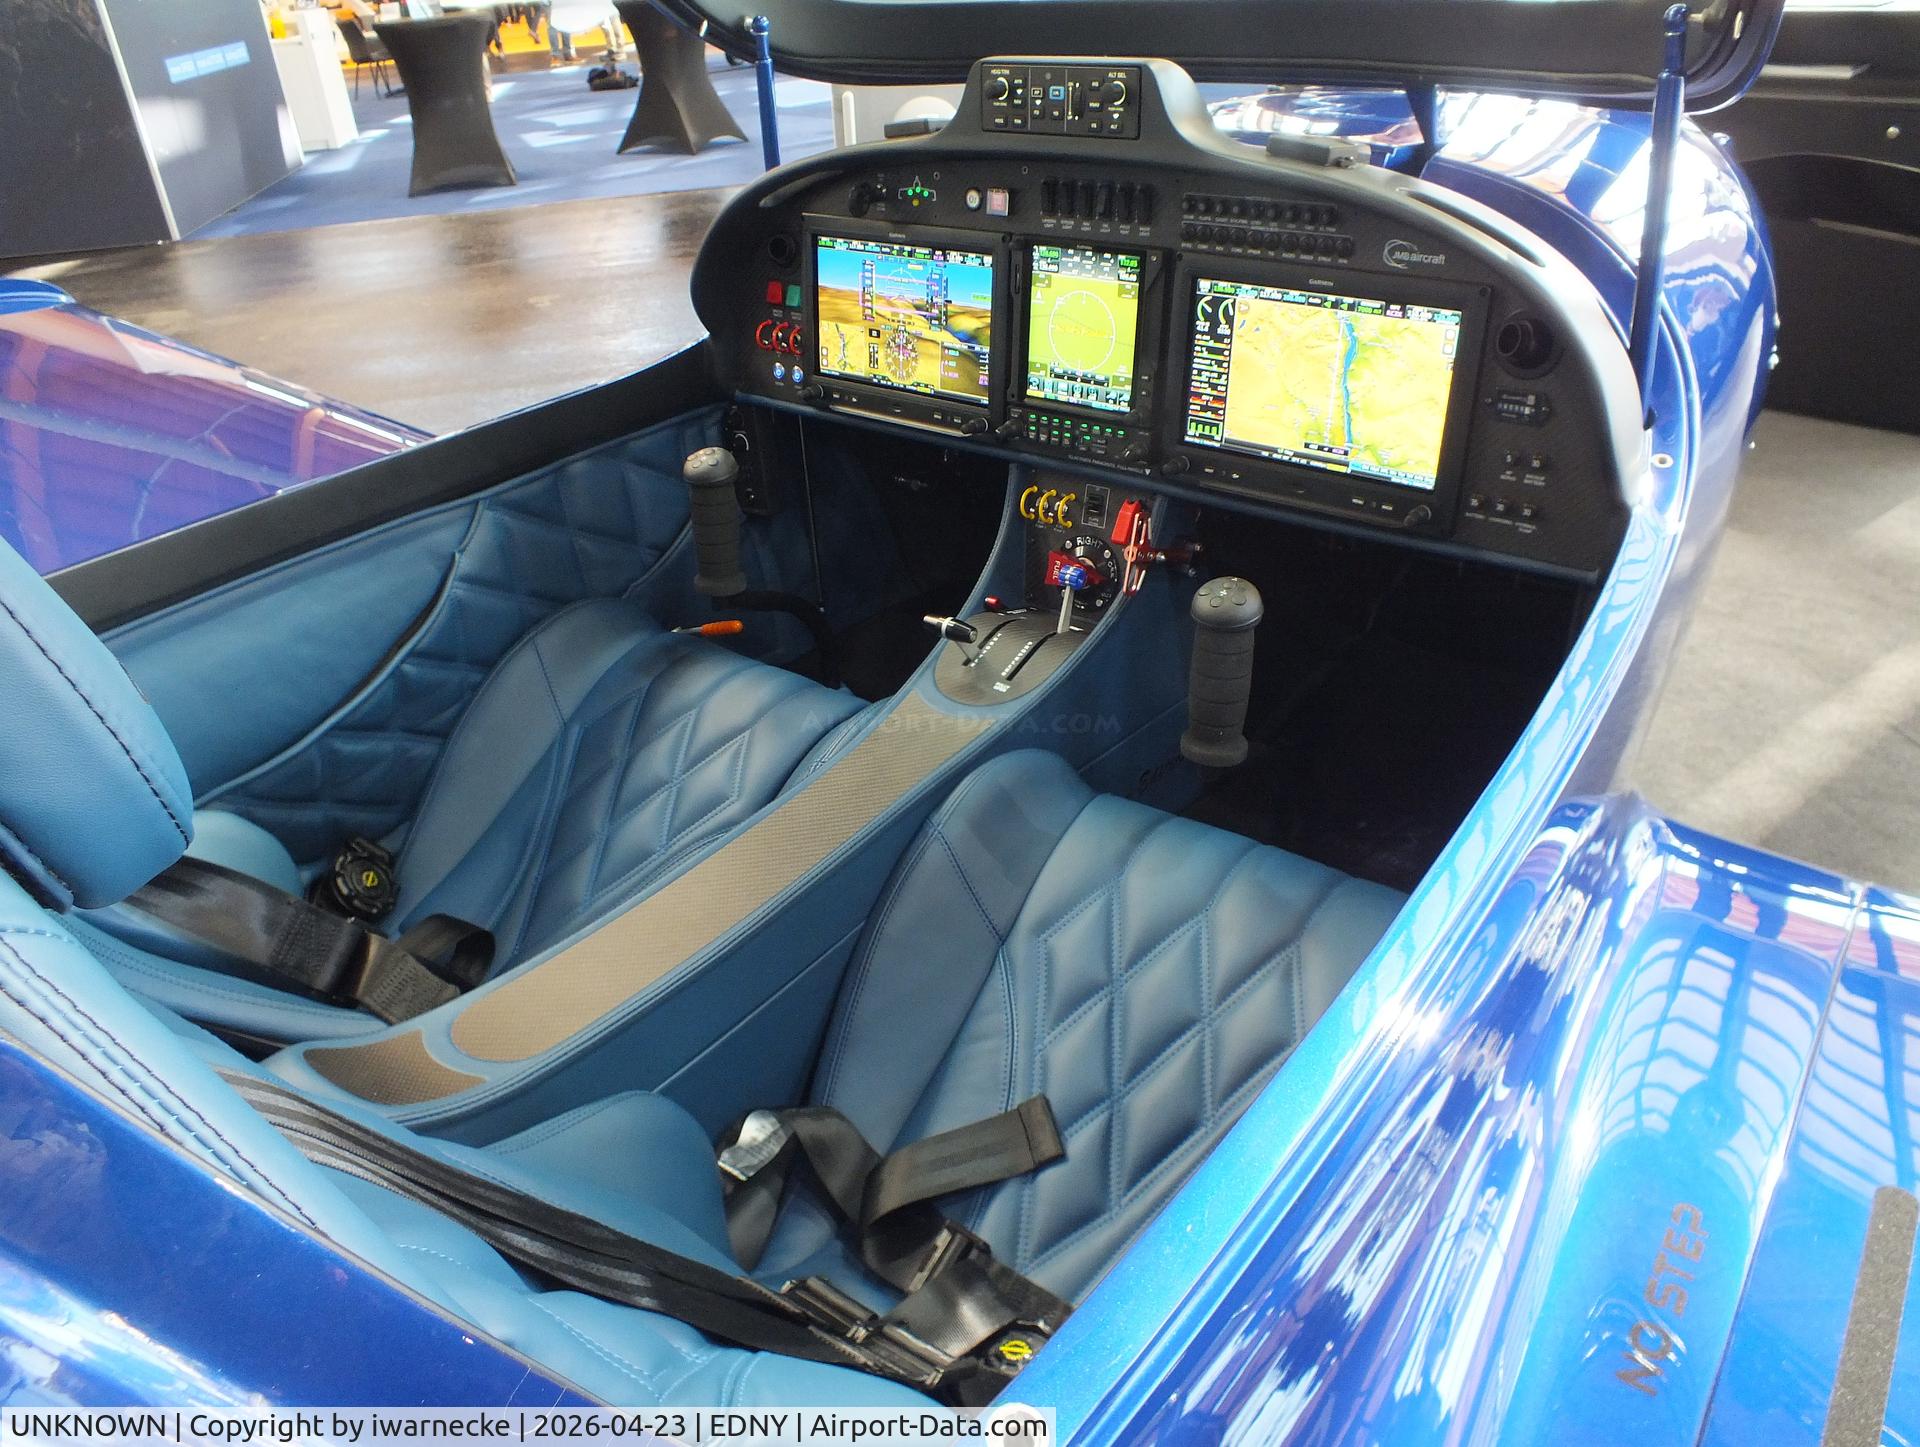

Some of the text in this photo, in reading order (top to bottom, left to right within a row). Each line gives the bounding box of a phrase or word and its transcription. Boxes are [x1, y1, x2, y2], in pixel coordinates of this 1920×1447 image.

[1076, 536, 1103, 549] RIGHT
[1052, 560, 1061, 580] FUEL
[1615, 1202, 1710, 1397] NO STEP
